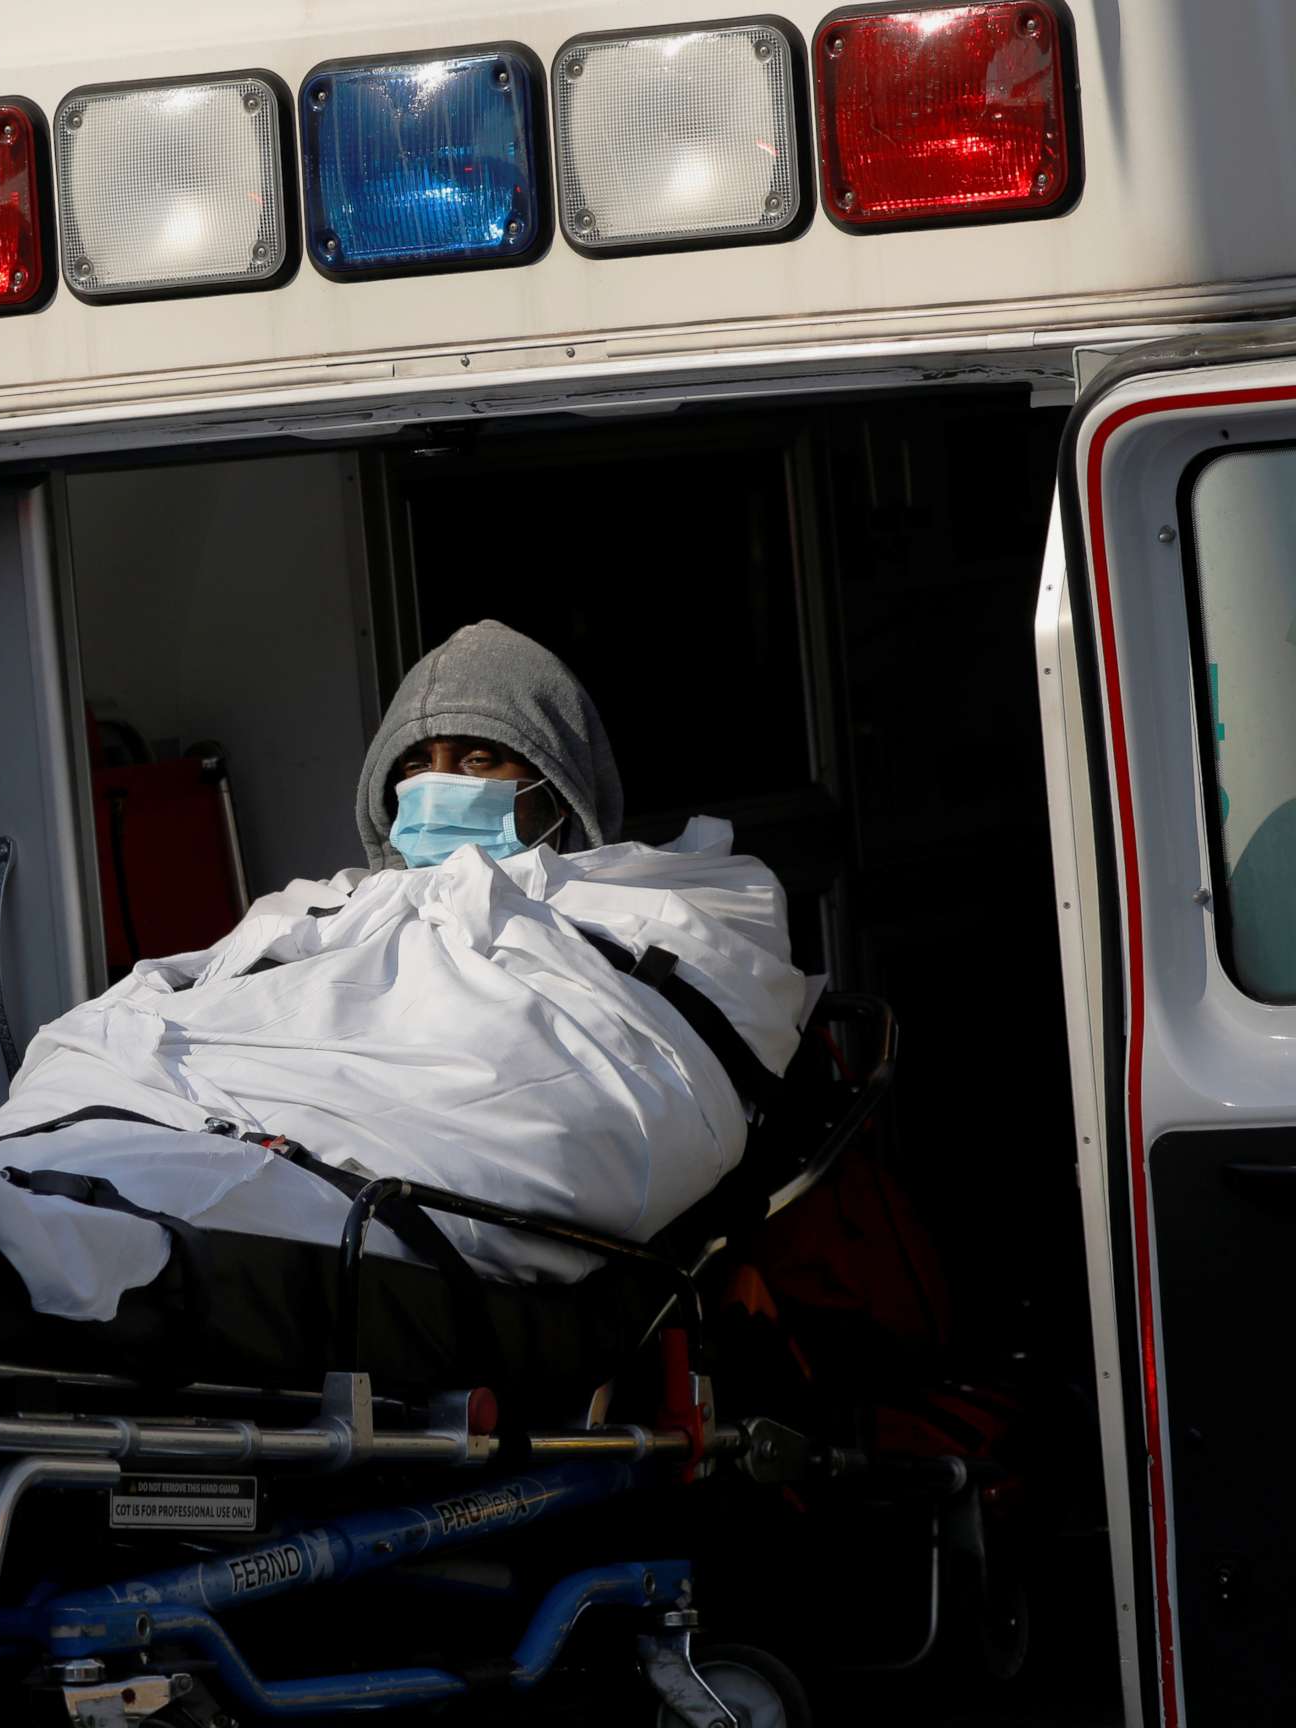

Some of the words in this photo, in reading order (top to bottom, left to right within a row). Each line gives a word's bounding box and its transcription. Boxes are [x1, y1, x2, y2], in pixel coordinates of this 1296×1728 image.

[115, 1503, 131, 1517] COT
[132, 1503, 140, 1517] IS
[141, 1503, 157, 1517] FOR
[158, 1503, 215, 1519] PROFESSIONAL
[216, 1505, 231, 1519] USE
[232, 1505, 251, 1519] ONLY
[228, 1543, 302, 1594] FERNO
